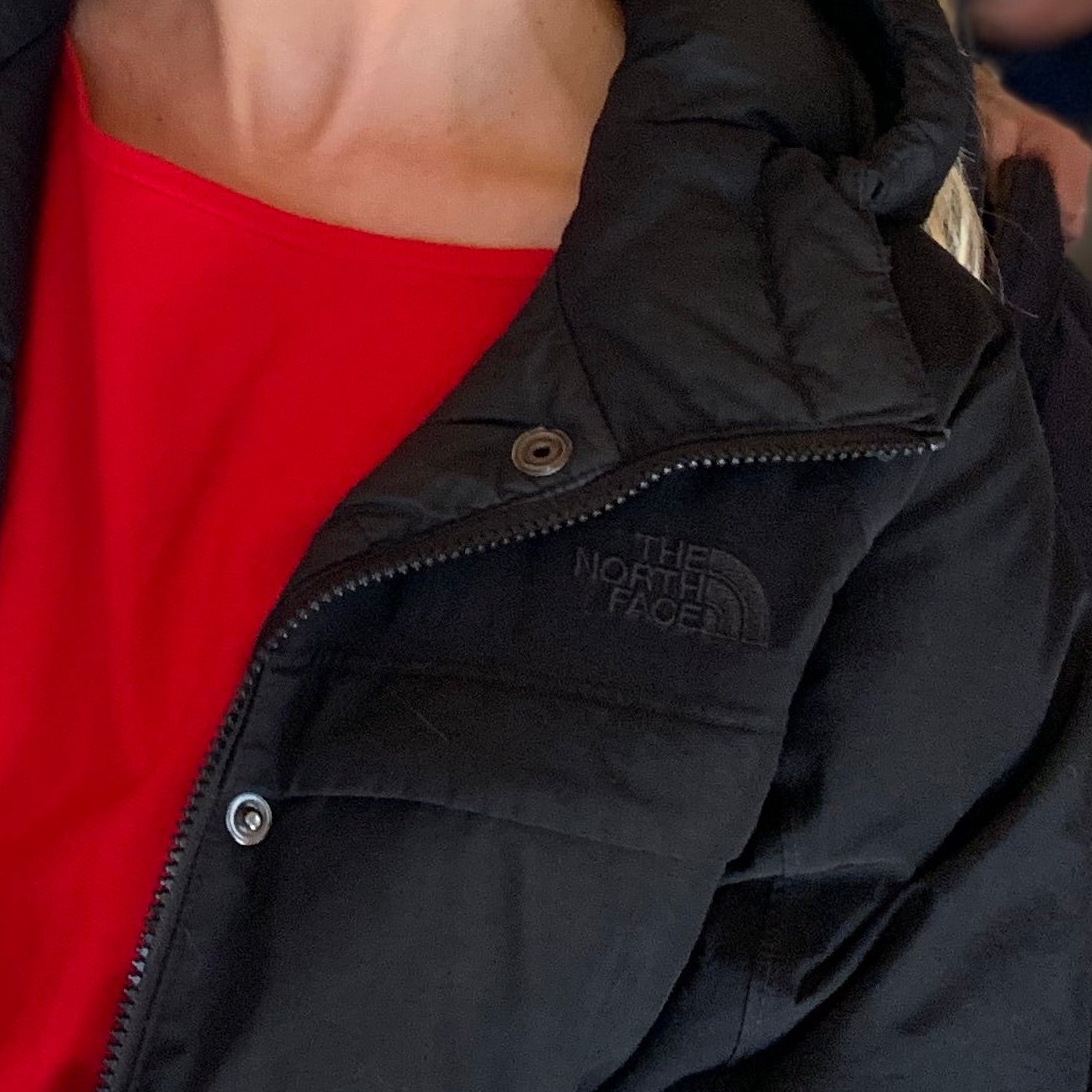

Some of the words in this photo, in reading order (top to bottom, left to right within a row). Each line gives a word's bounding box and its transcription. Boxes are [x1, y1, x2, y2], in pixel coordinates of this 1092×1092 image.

[633, 532, 709, 572] THE
[574, 547, 705, 602] NORTH
[609, 587, 704, 631] FACE
